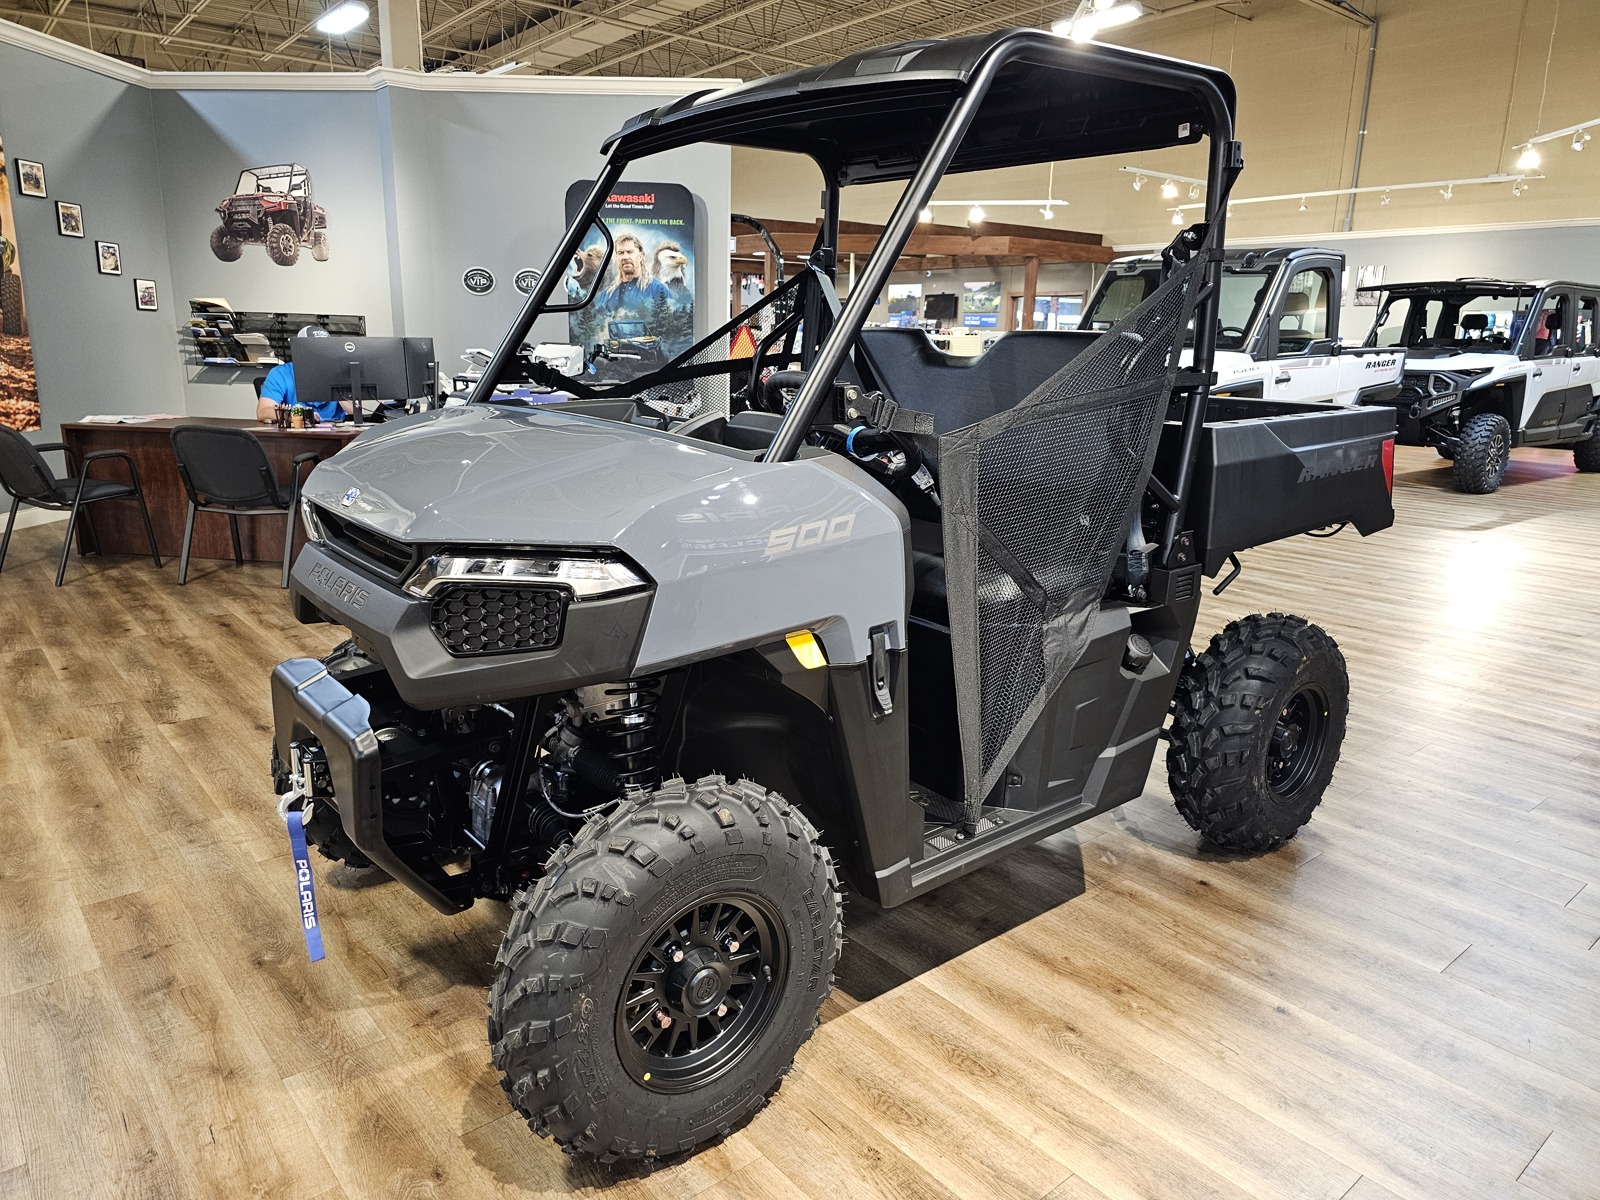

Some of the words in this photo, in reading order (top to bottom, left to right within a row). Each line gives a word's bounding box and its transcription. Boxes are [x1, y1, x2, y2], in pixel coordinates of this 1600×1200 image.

[470, 276, 487, 286] VIP
[1365, 358, 1397, 370] RANGER
[1296, 454, 1378, 484] RANGER
[763, 514, 856, 556] 500
[308, 562, 370, 610] POLARIS
[296, 859, 316, 930] POLARIS
